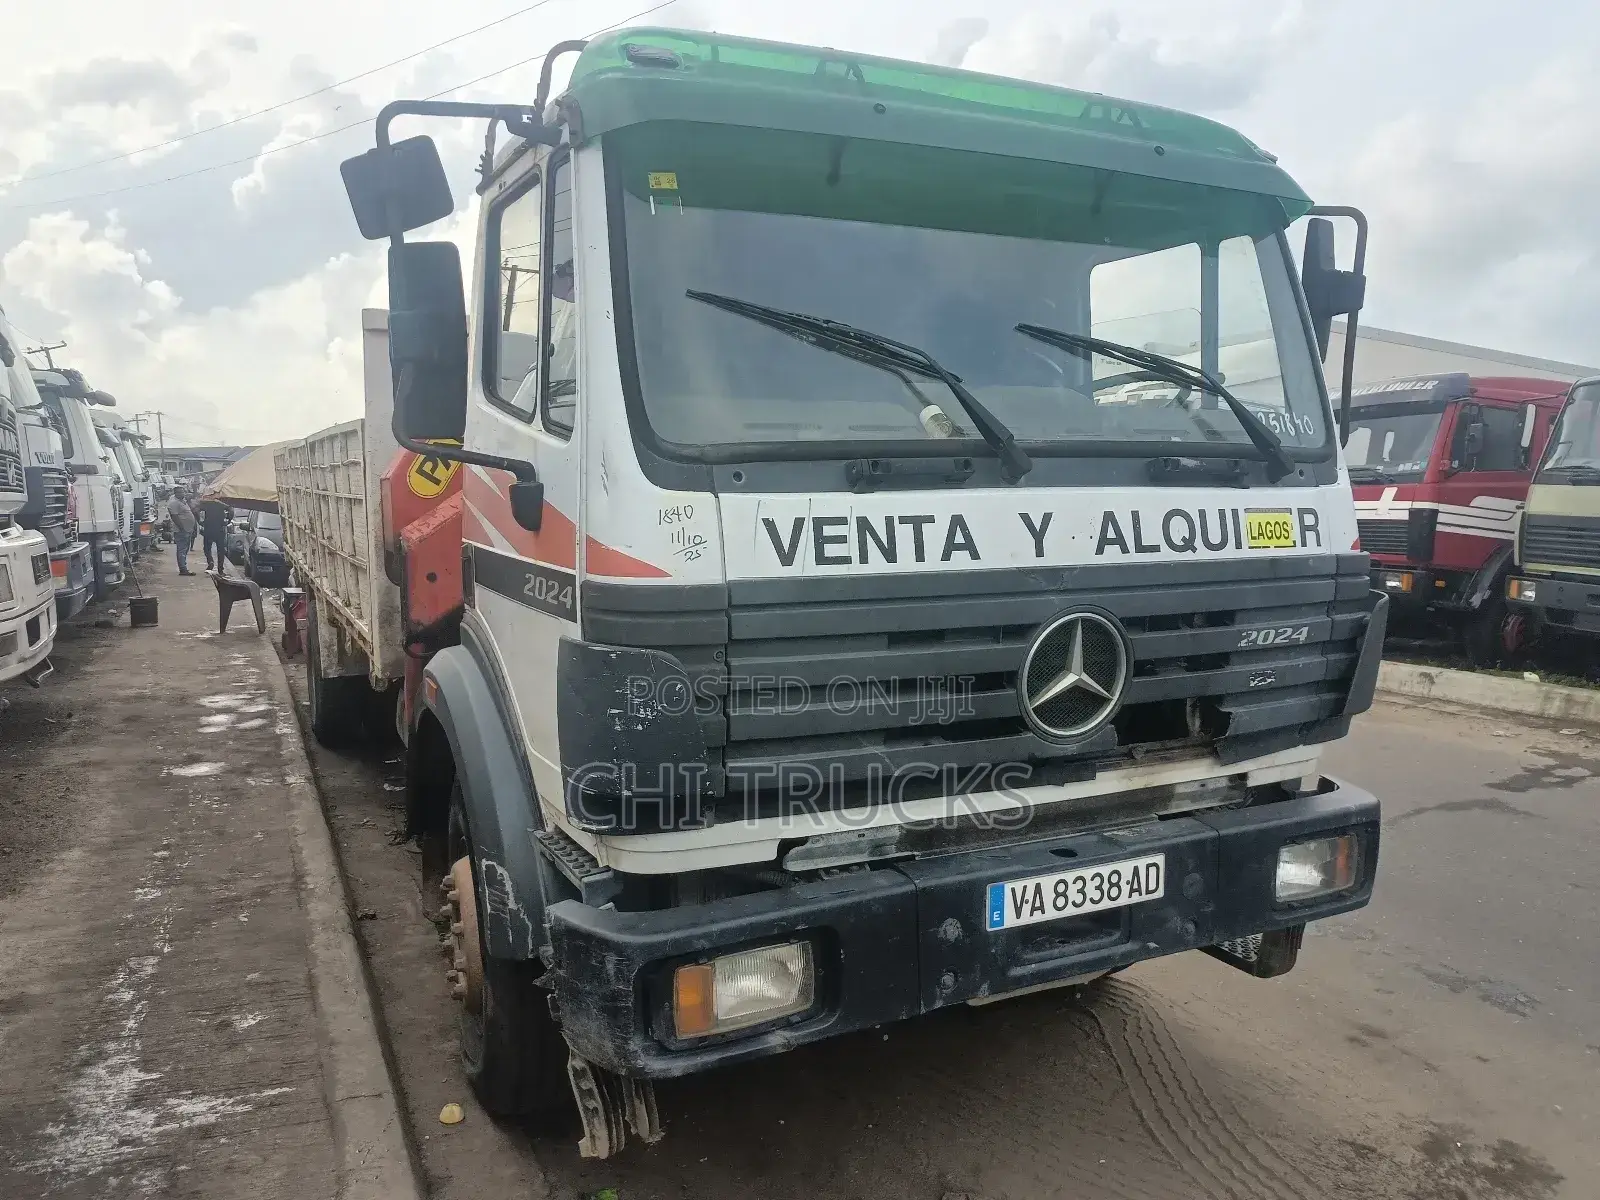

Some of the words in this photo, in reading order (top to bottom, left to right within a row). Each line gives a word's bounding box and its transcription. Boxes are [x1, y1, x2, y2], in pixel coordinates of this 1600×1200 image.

[659, 504, 694, 525] 1840
[761, 514, 981, 567] VENTA
[1018, 511, 1053, 557] Y
[1095, 507, 1322, 555] ALQUIR
[1248, 520, 1290, 541] LAGOS
[523, 573, 573, 609] 2024
[1237, 626, 1309, 647] 2024
[993, 912, 1001, 921] E
